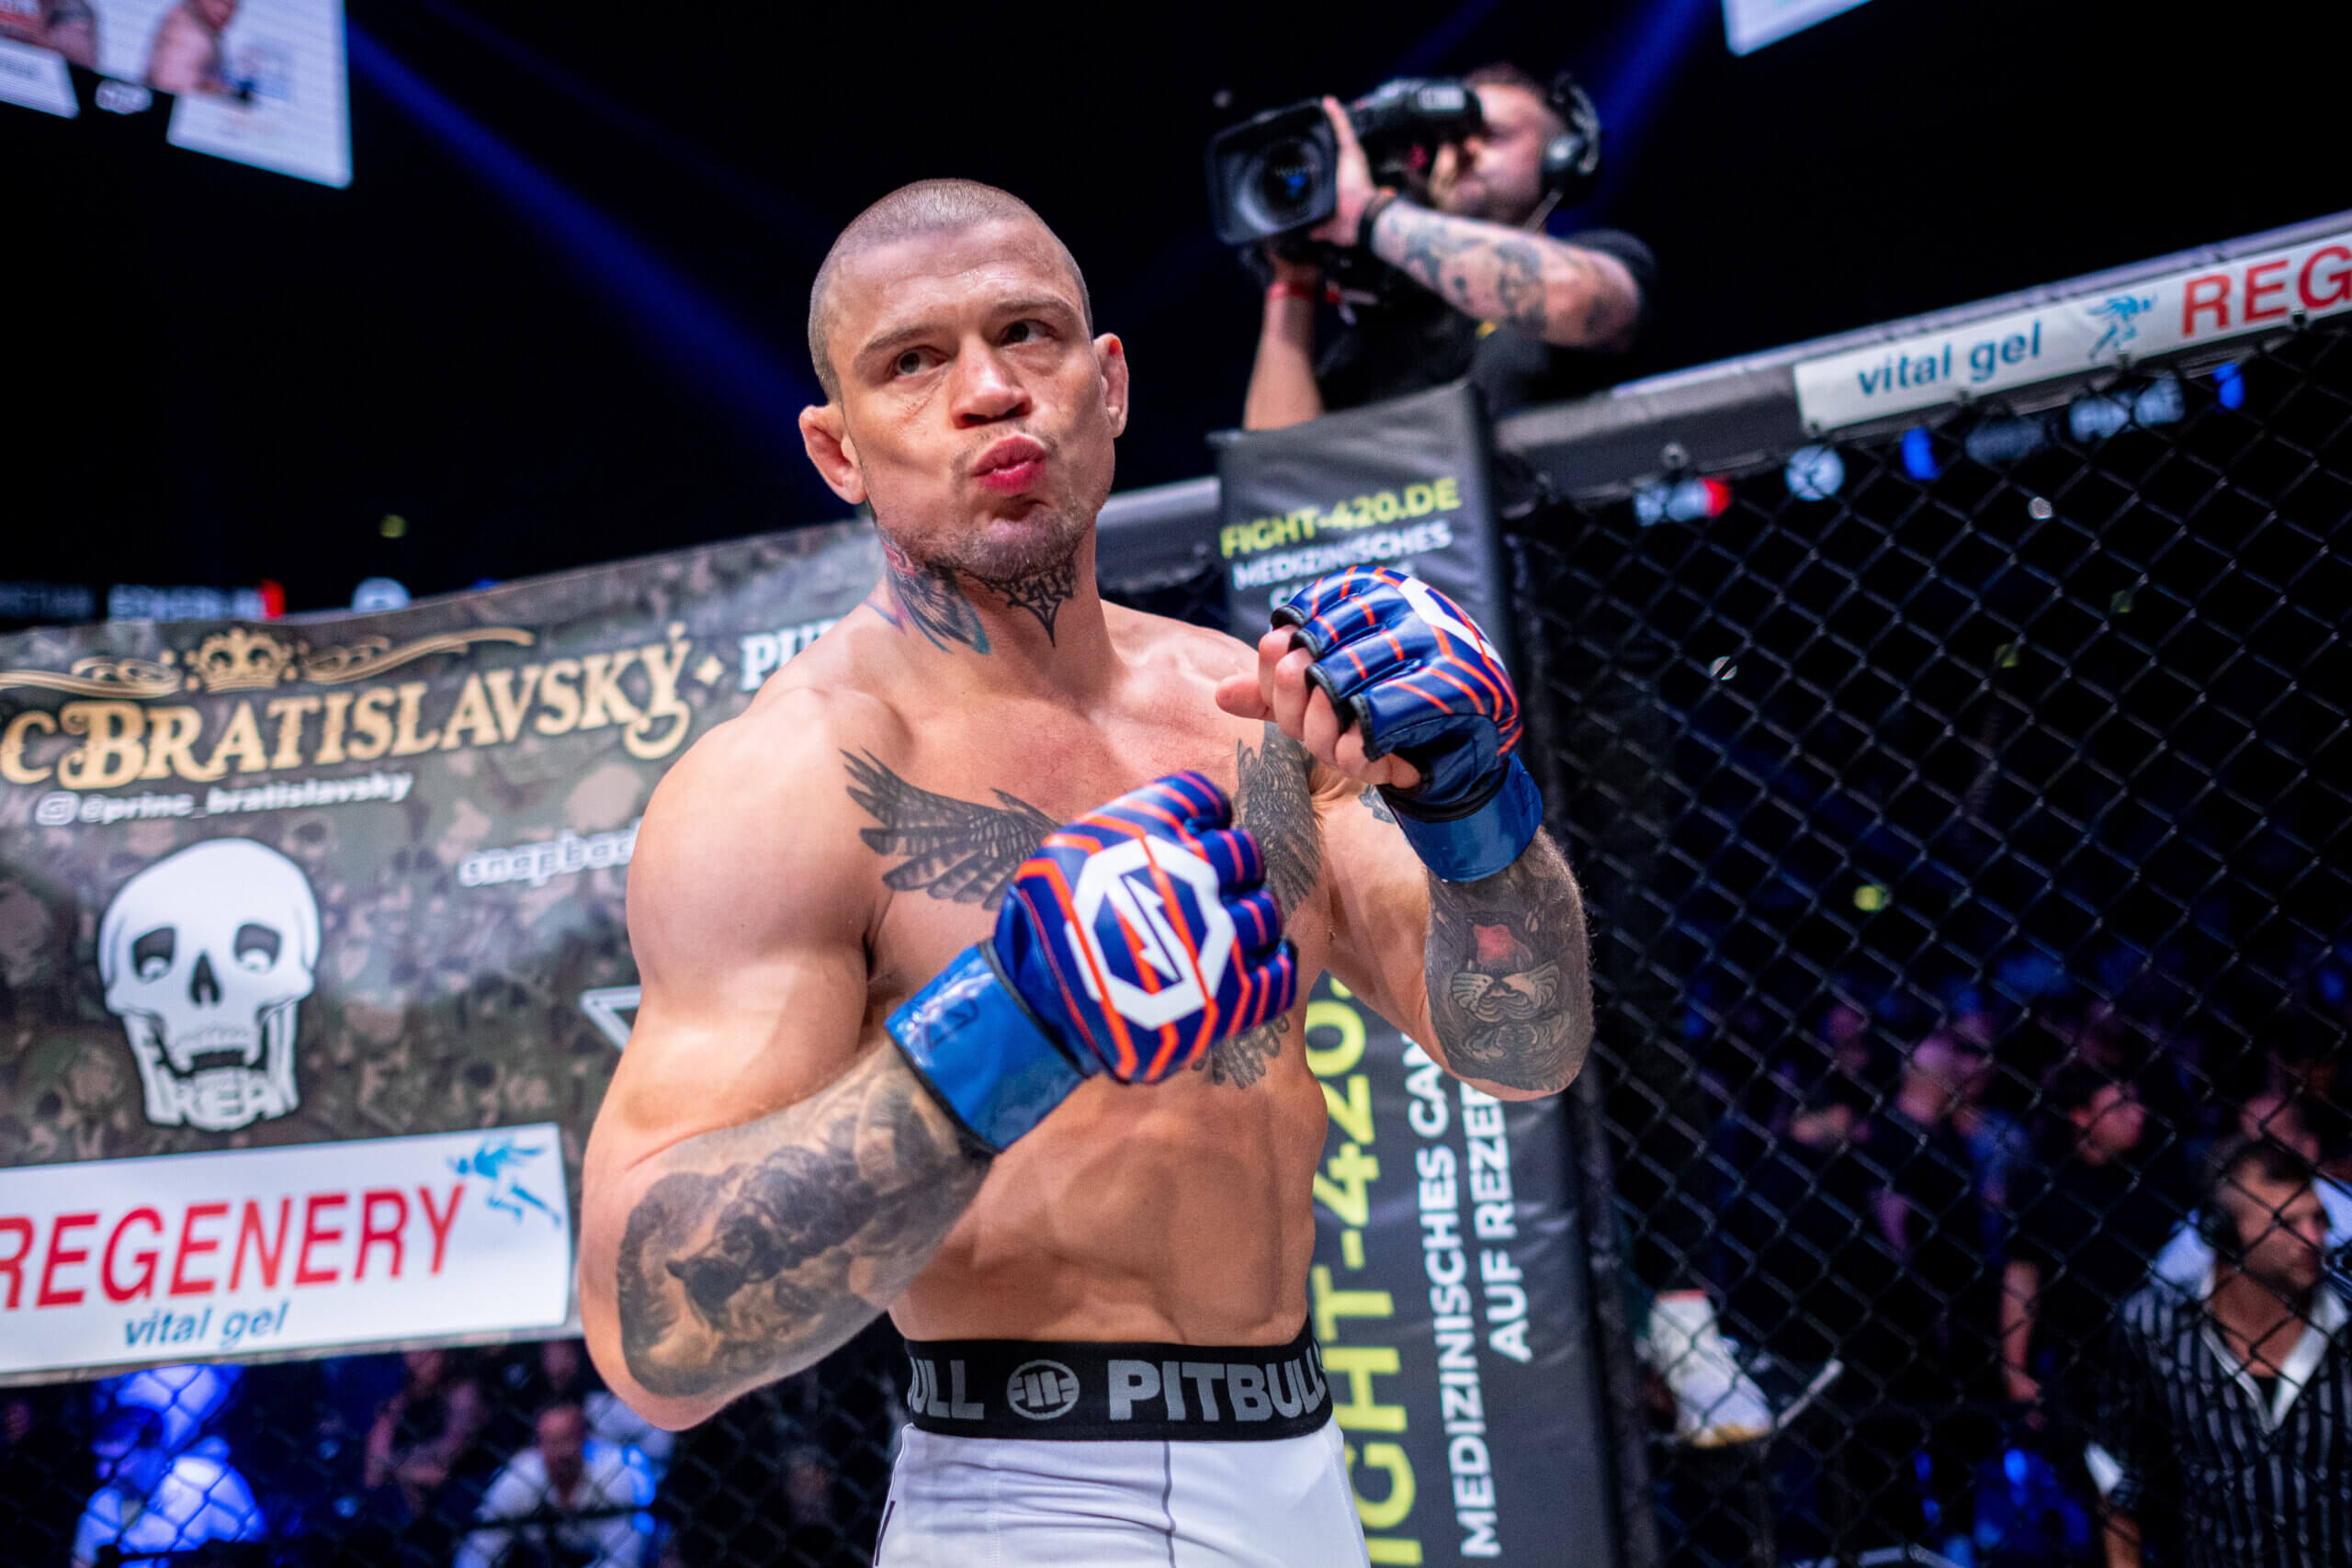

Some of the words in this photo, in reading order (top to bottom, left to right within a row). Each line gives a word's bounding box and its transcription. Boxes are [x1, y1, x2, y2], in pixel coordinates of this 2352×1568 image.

[2181, 245, 2352, 338] REG
[1858, 343, 1952, 397] vital
[1969, 320, 2042, 382] gel
[1220, 477, 1462, 558] FIGHT-420.DE
[1233, 520, 1453, 590] MEDIZINISCHES
[58, 621, 692, 790] BRATISLAVSKÝ
[124, 1307, 212, 1348] vital
[219, 1301, 289, 1349] gel
[1479, 1248, 1533, 1363] AUF
[908, 1357, 985, 1420] ULL
[1107, 1345, 1327, 1423] PITBULL
[1415, 1145, 1502, 1558] MEDIZINISCHES
